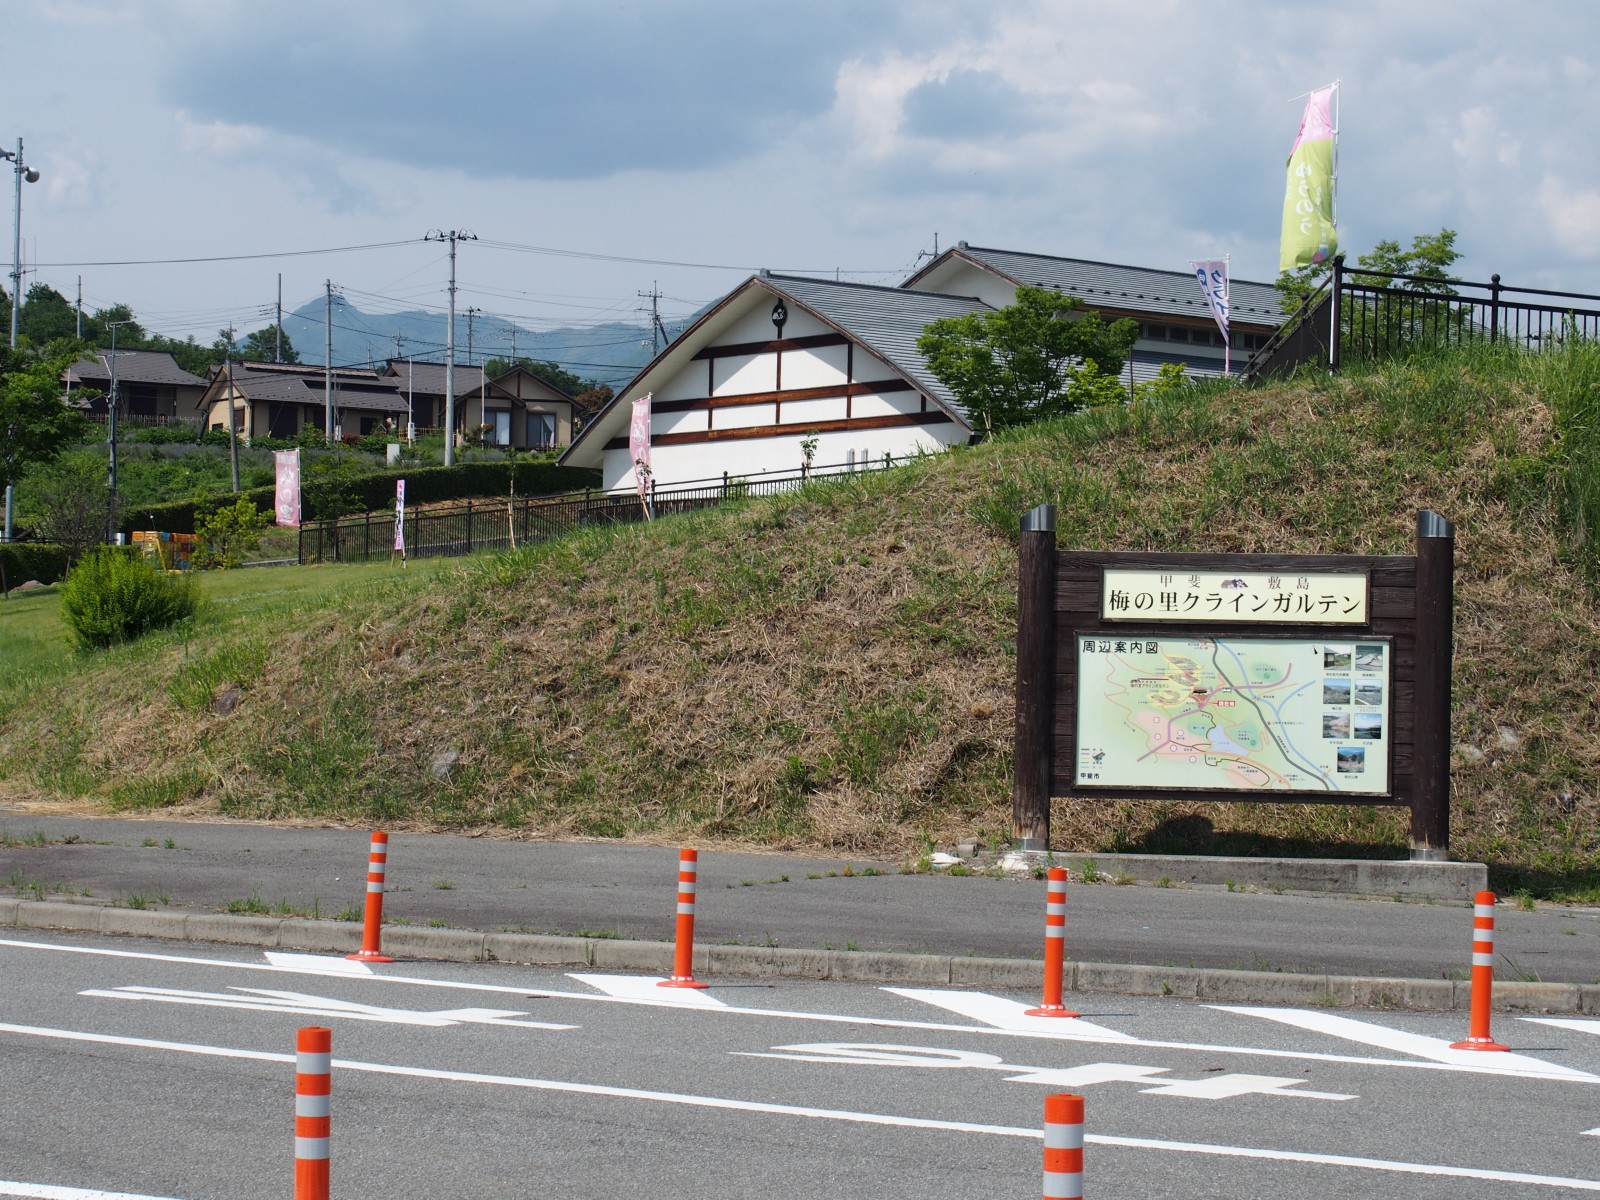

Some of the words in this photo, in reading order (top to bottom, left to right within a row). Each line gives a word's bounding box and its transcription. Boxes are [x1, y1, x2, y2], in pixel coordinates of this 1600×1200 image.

[1159, 573, 1202, 589] 甲斐
[1267, 575, 1310, 590] 敷島
[1108, 588, 1362, 616] 梅の里クラインガルテン
[1082, 640, 1158, 654] 周辺案内図
